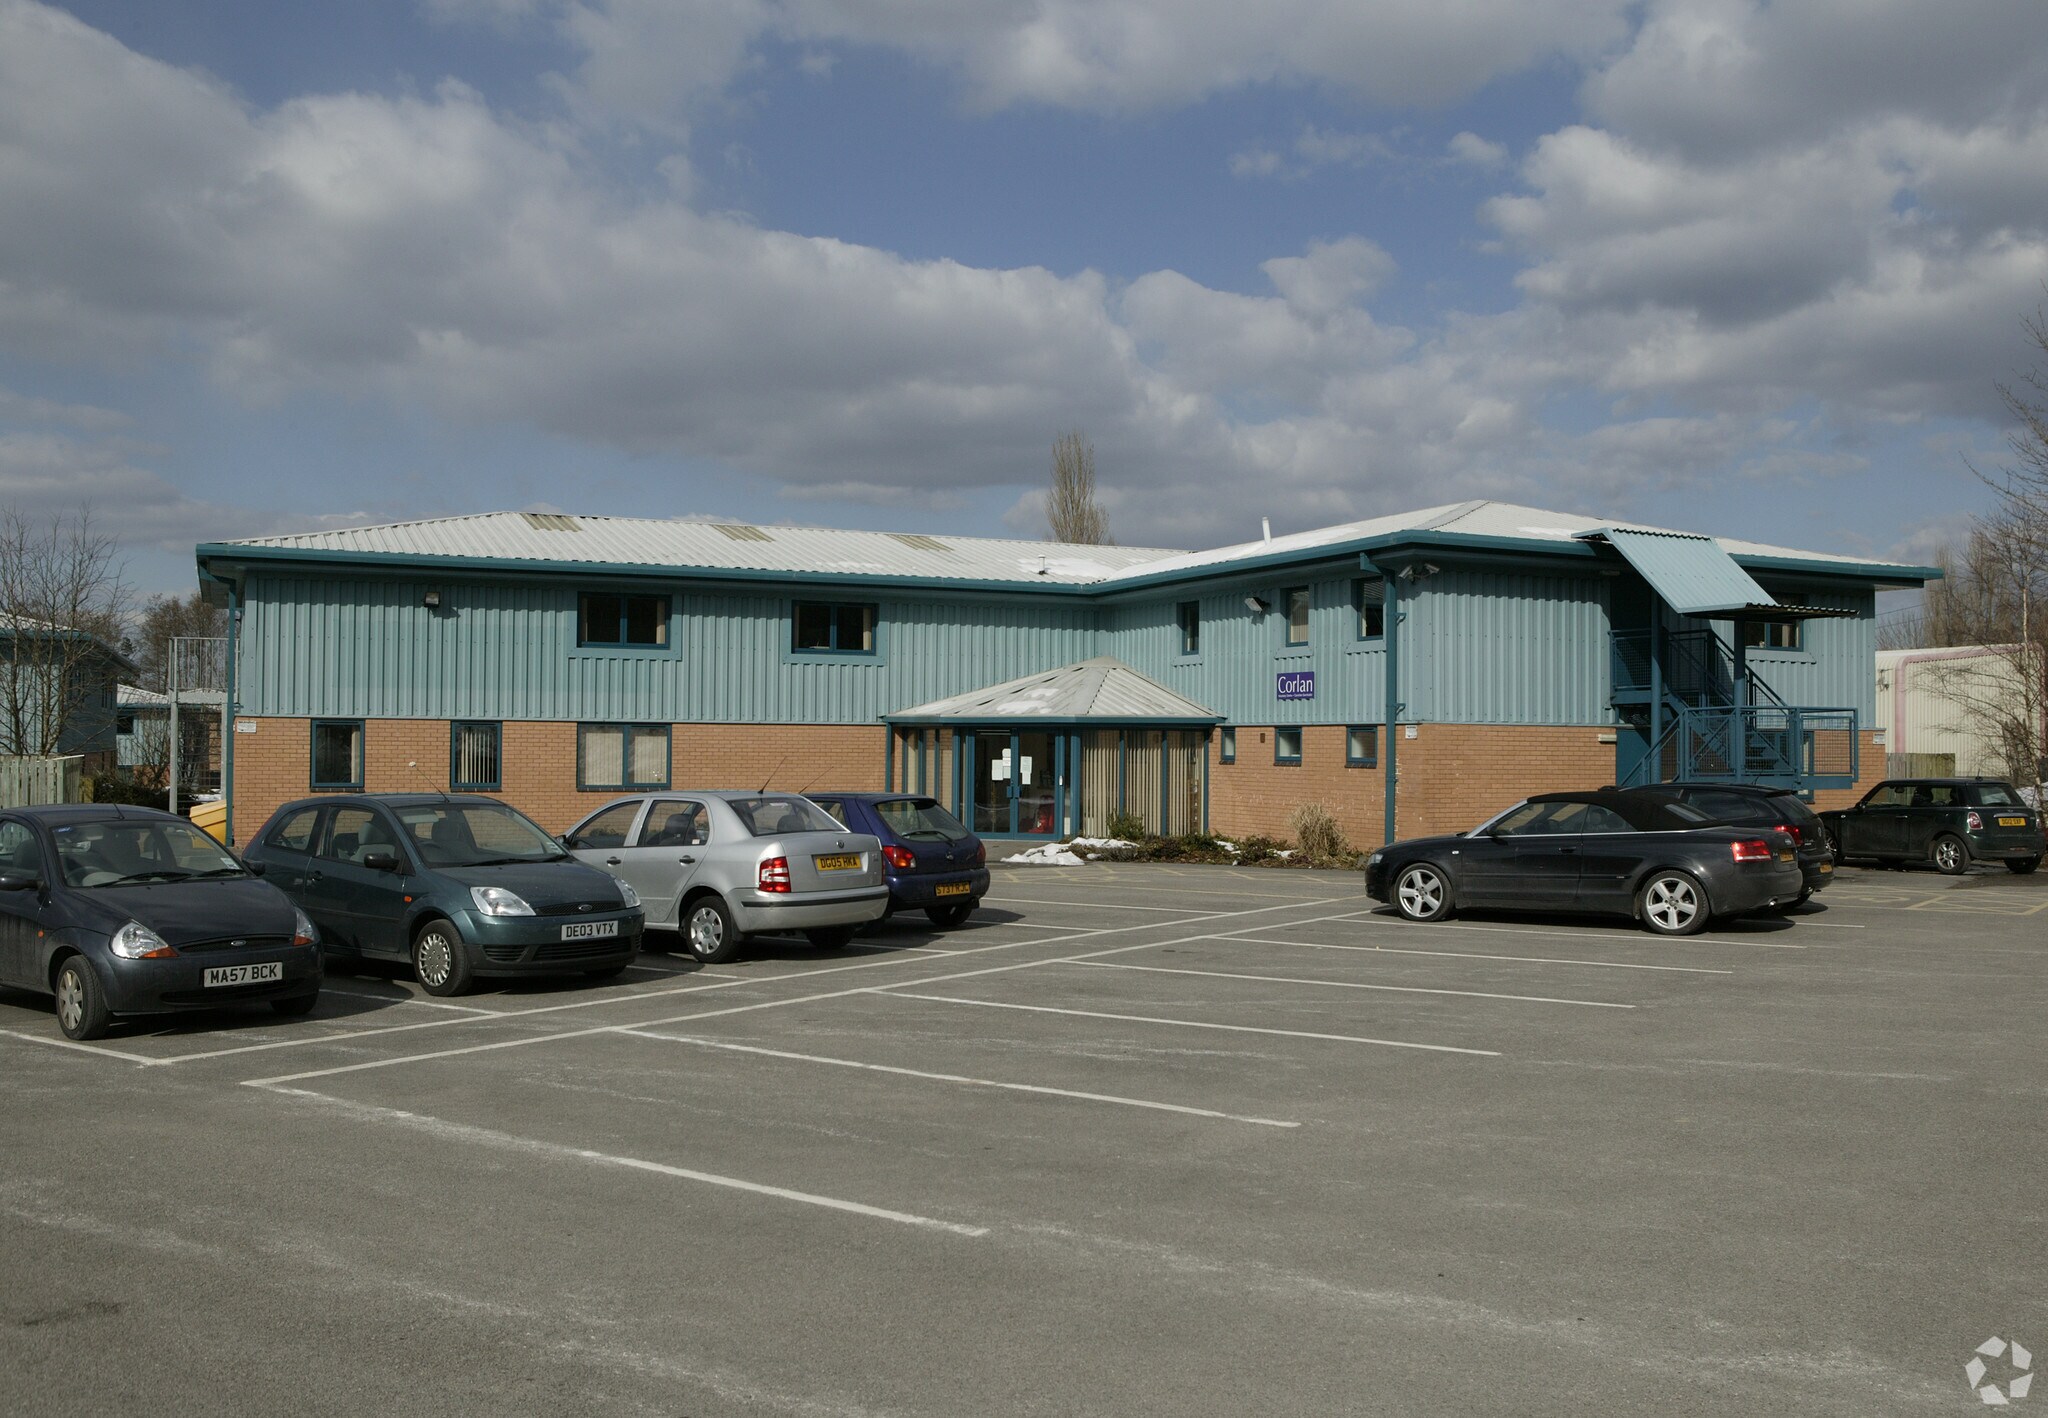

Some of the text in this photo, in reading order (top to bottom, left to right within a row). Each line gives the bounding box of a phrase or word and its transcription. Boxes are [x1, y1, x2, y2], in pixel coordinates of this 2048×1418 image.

[1278, 674, 1313, 693] Corlan
[820, 857, 842, 868] DG05
[566, 922, 614, 938] DE03 VTX
[210, 964, 277, 983] MA57 BCK
